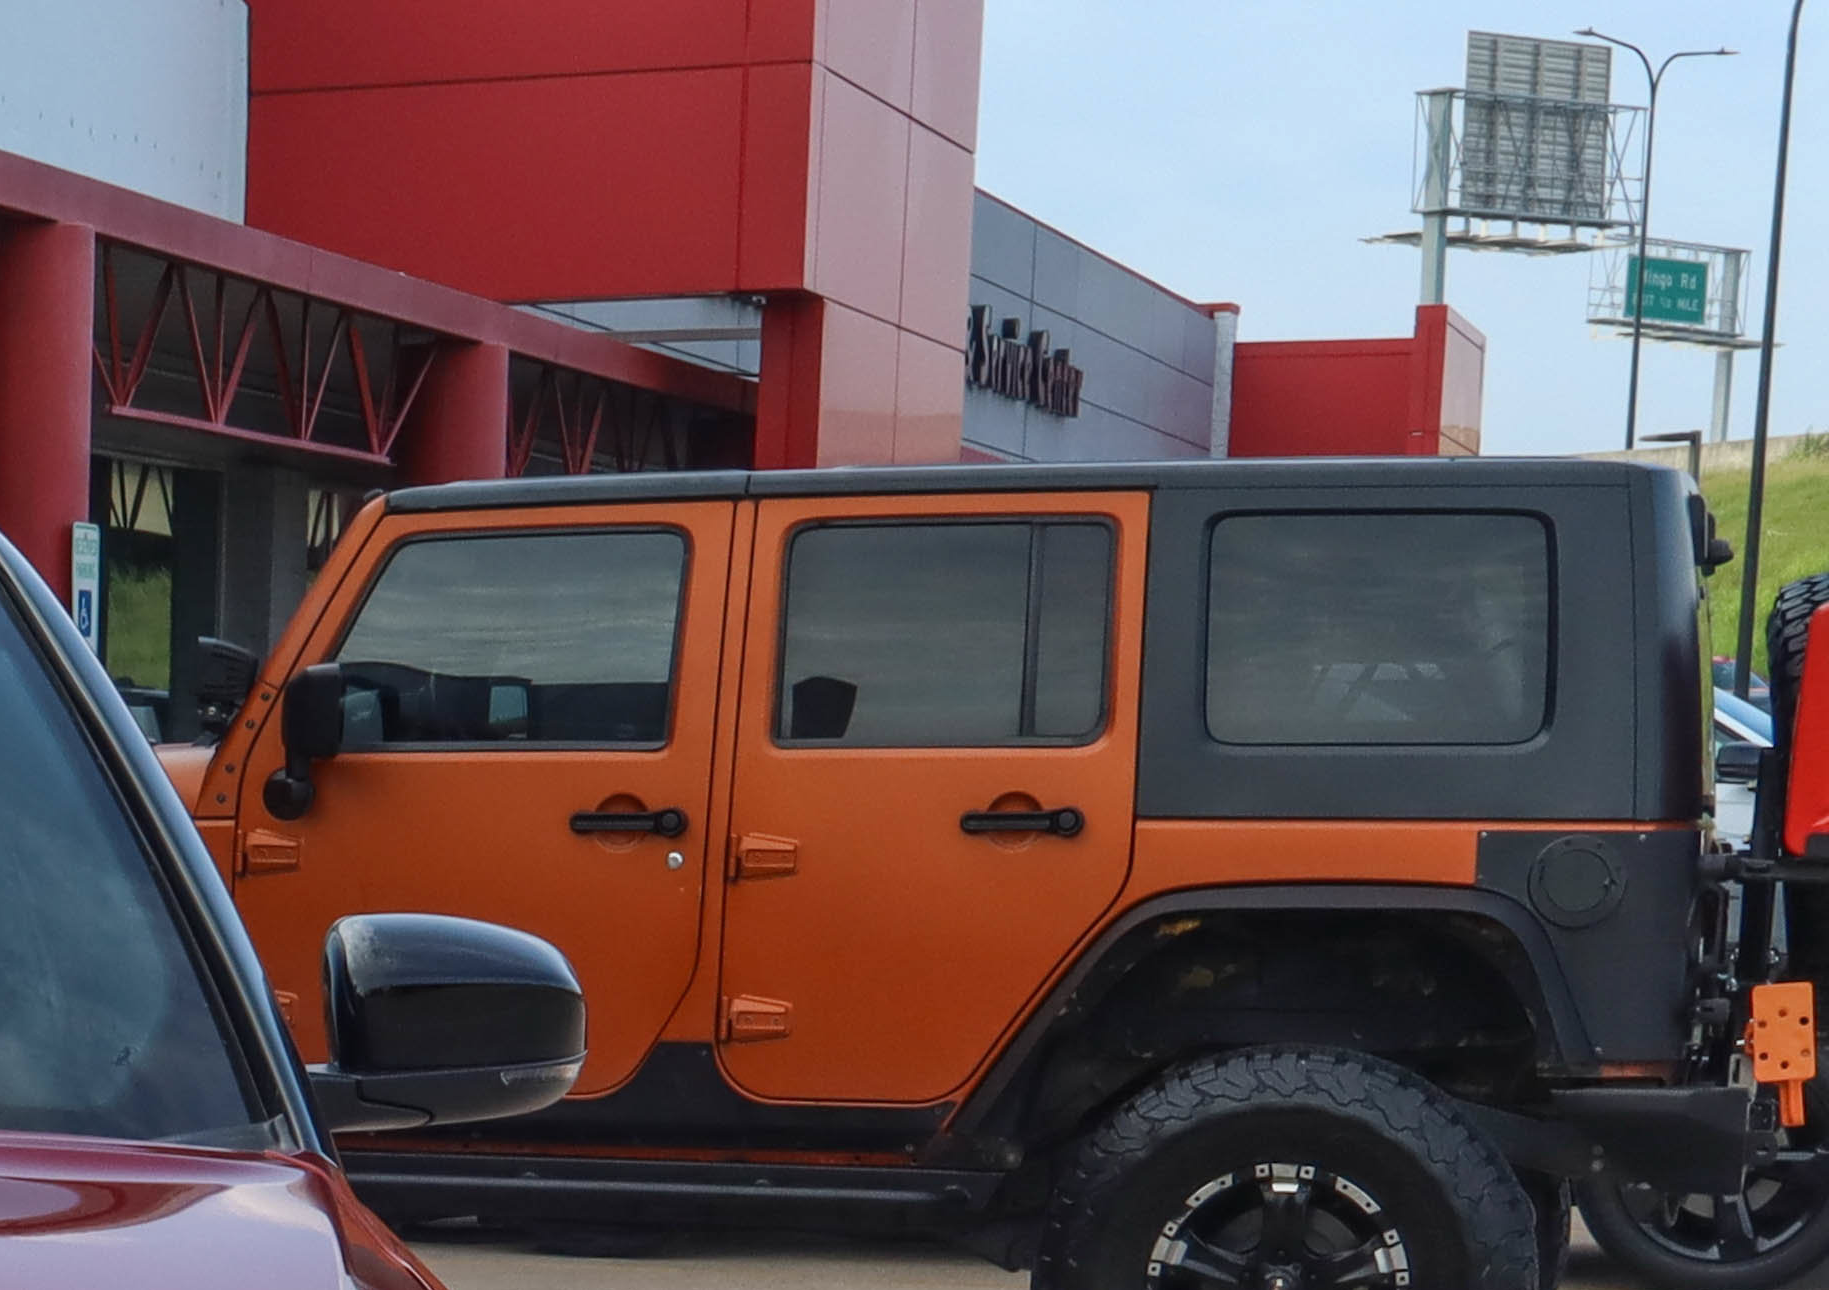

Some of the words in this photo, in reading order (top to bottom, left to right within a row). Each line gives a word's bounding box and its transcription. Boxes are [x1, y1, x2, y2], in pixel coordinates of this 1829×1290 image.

[1680, 272, 1697, 290] Rd
[1677, 298, 1699, 312] MILE
[969, 303, 1029, 401] Service
[1025, 329, 1084, 418] Center
